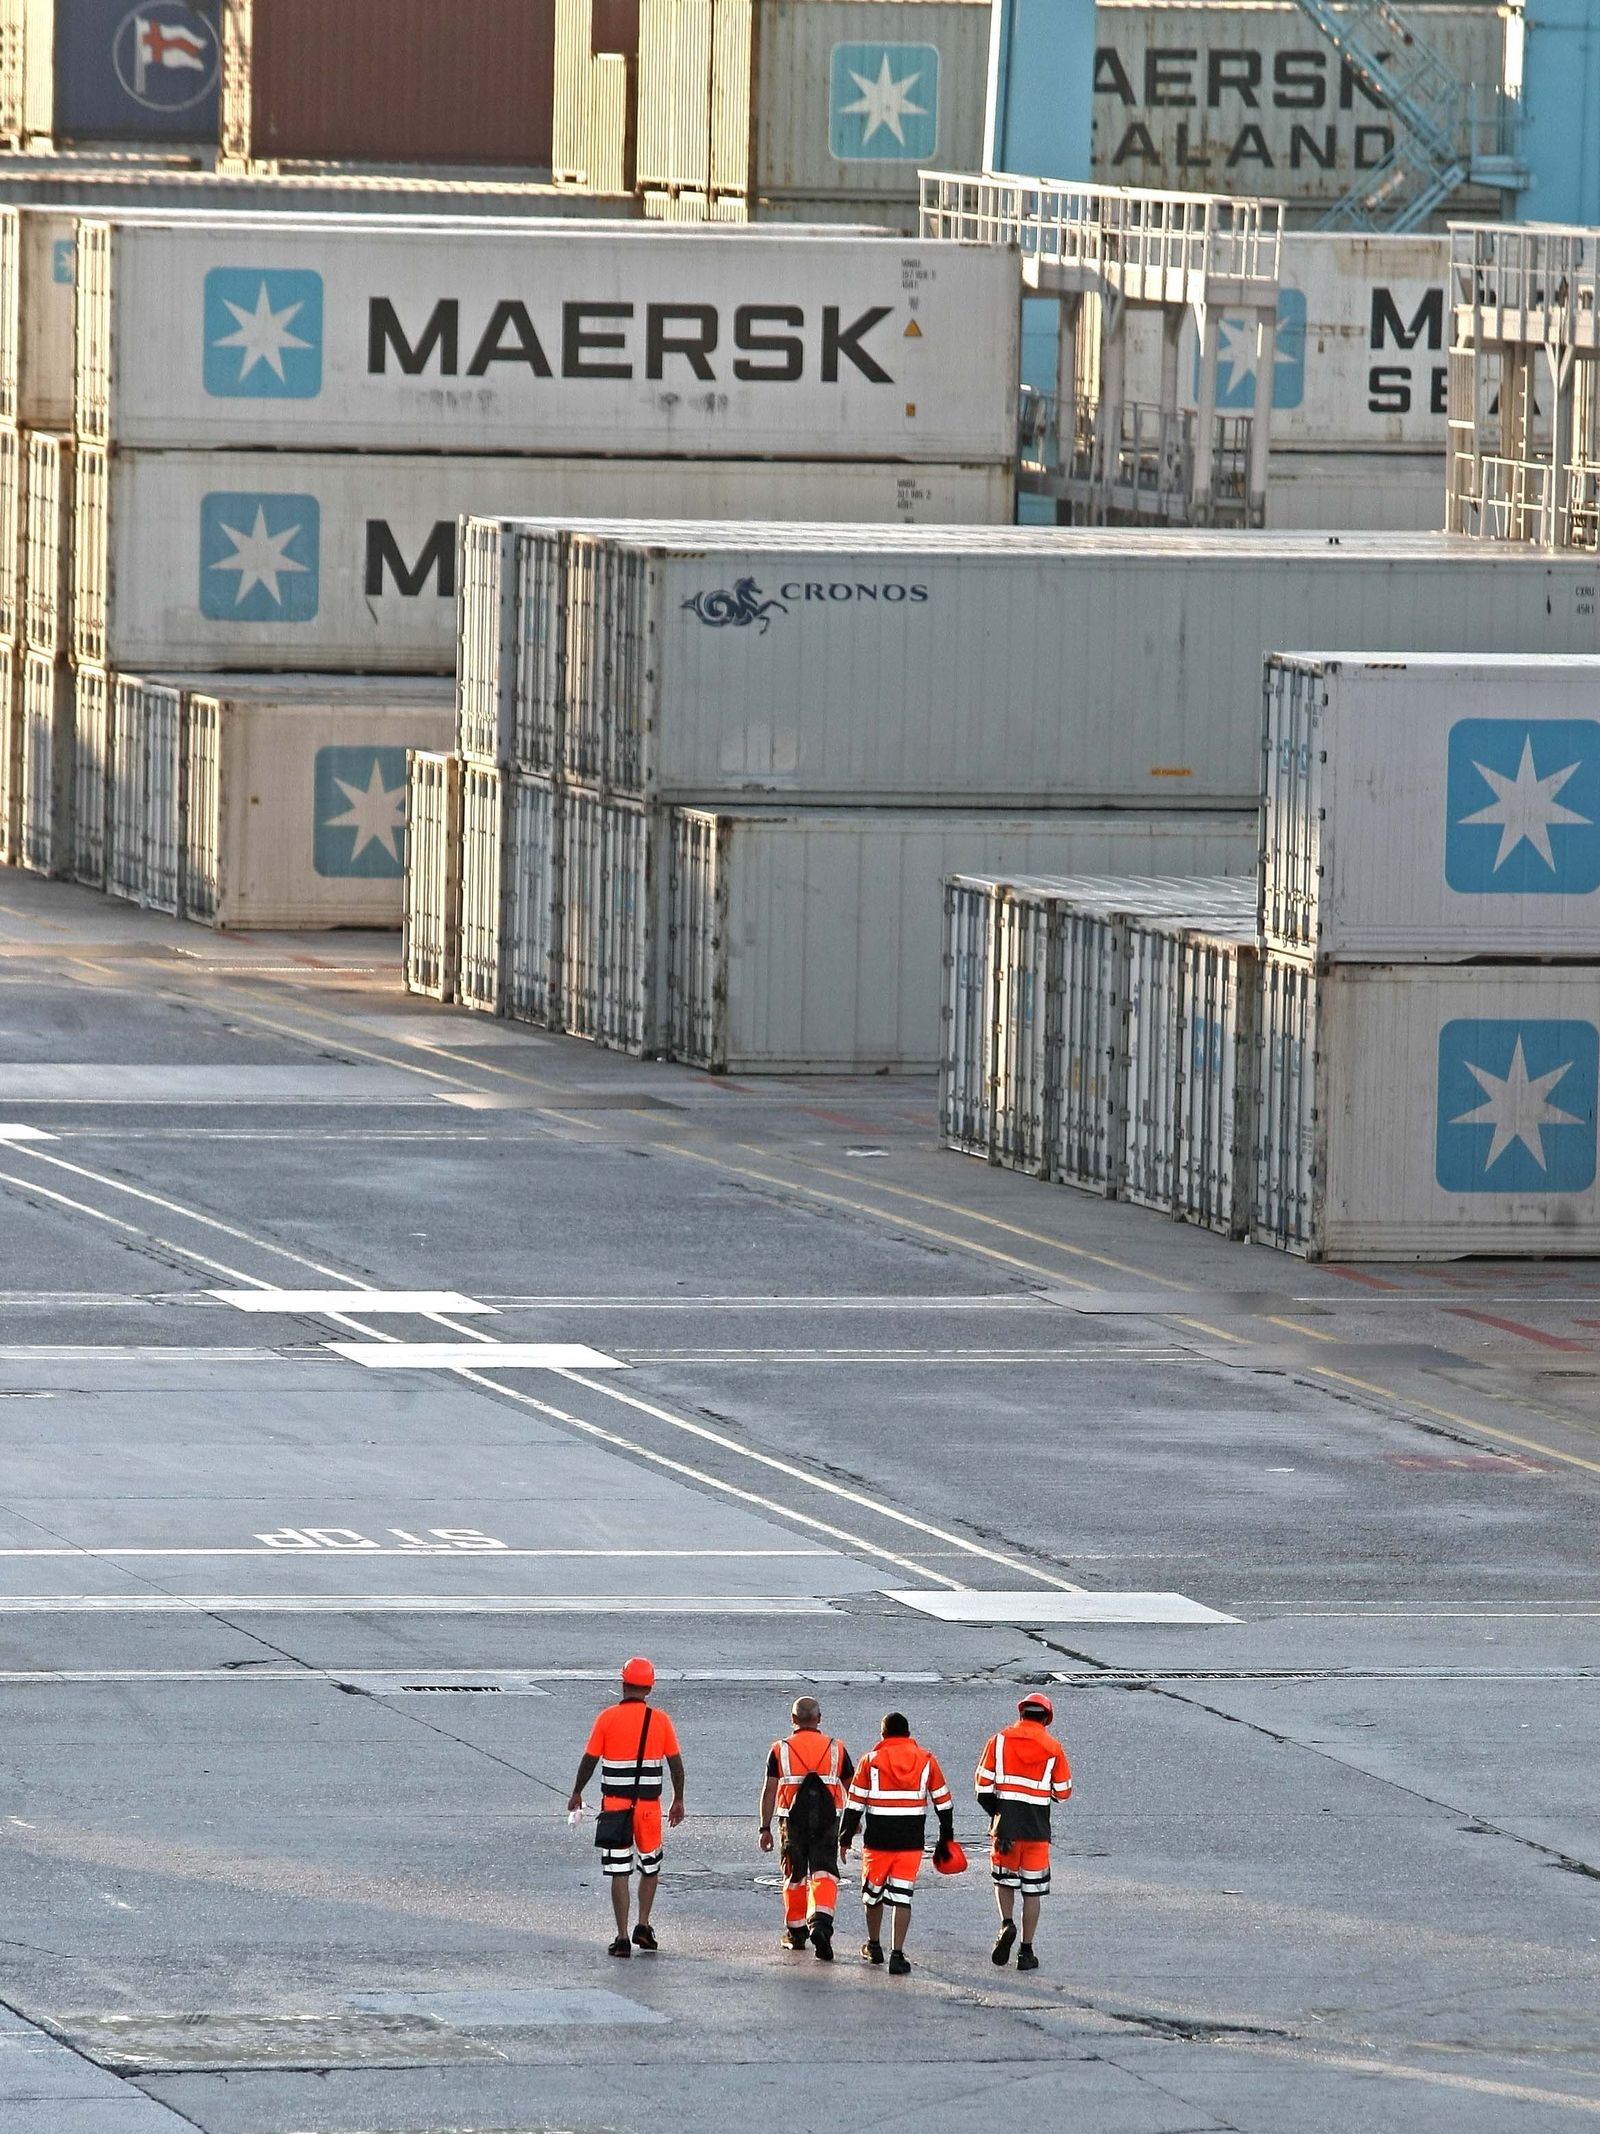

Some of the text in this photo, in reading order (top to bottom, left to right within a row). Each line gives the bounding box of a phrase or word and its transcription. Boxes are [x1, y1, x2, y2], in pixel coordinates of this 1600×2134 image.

[1093, 47, 1395, 110] AERSK
[1091, 121, 1395, 169] ALAND
[368, 297, 894, 384] MAERSK
[780, 583, 928, 602] CRONOS
[253, 1528, 510, 1549] STOP
